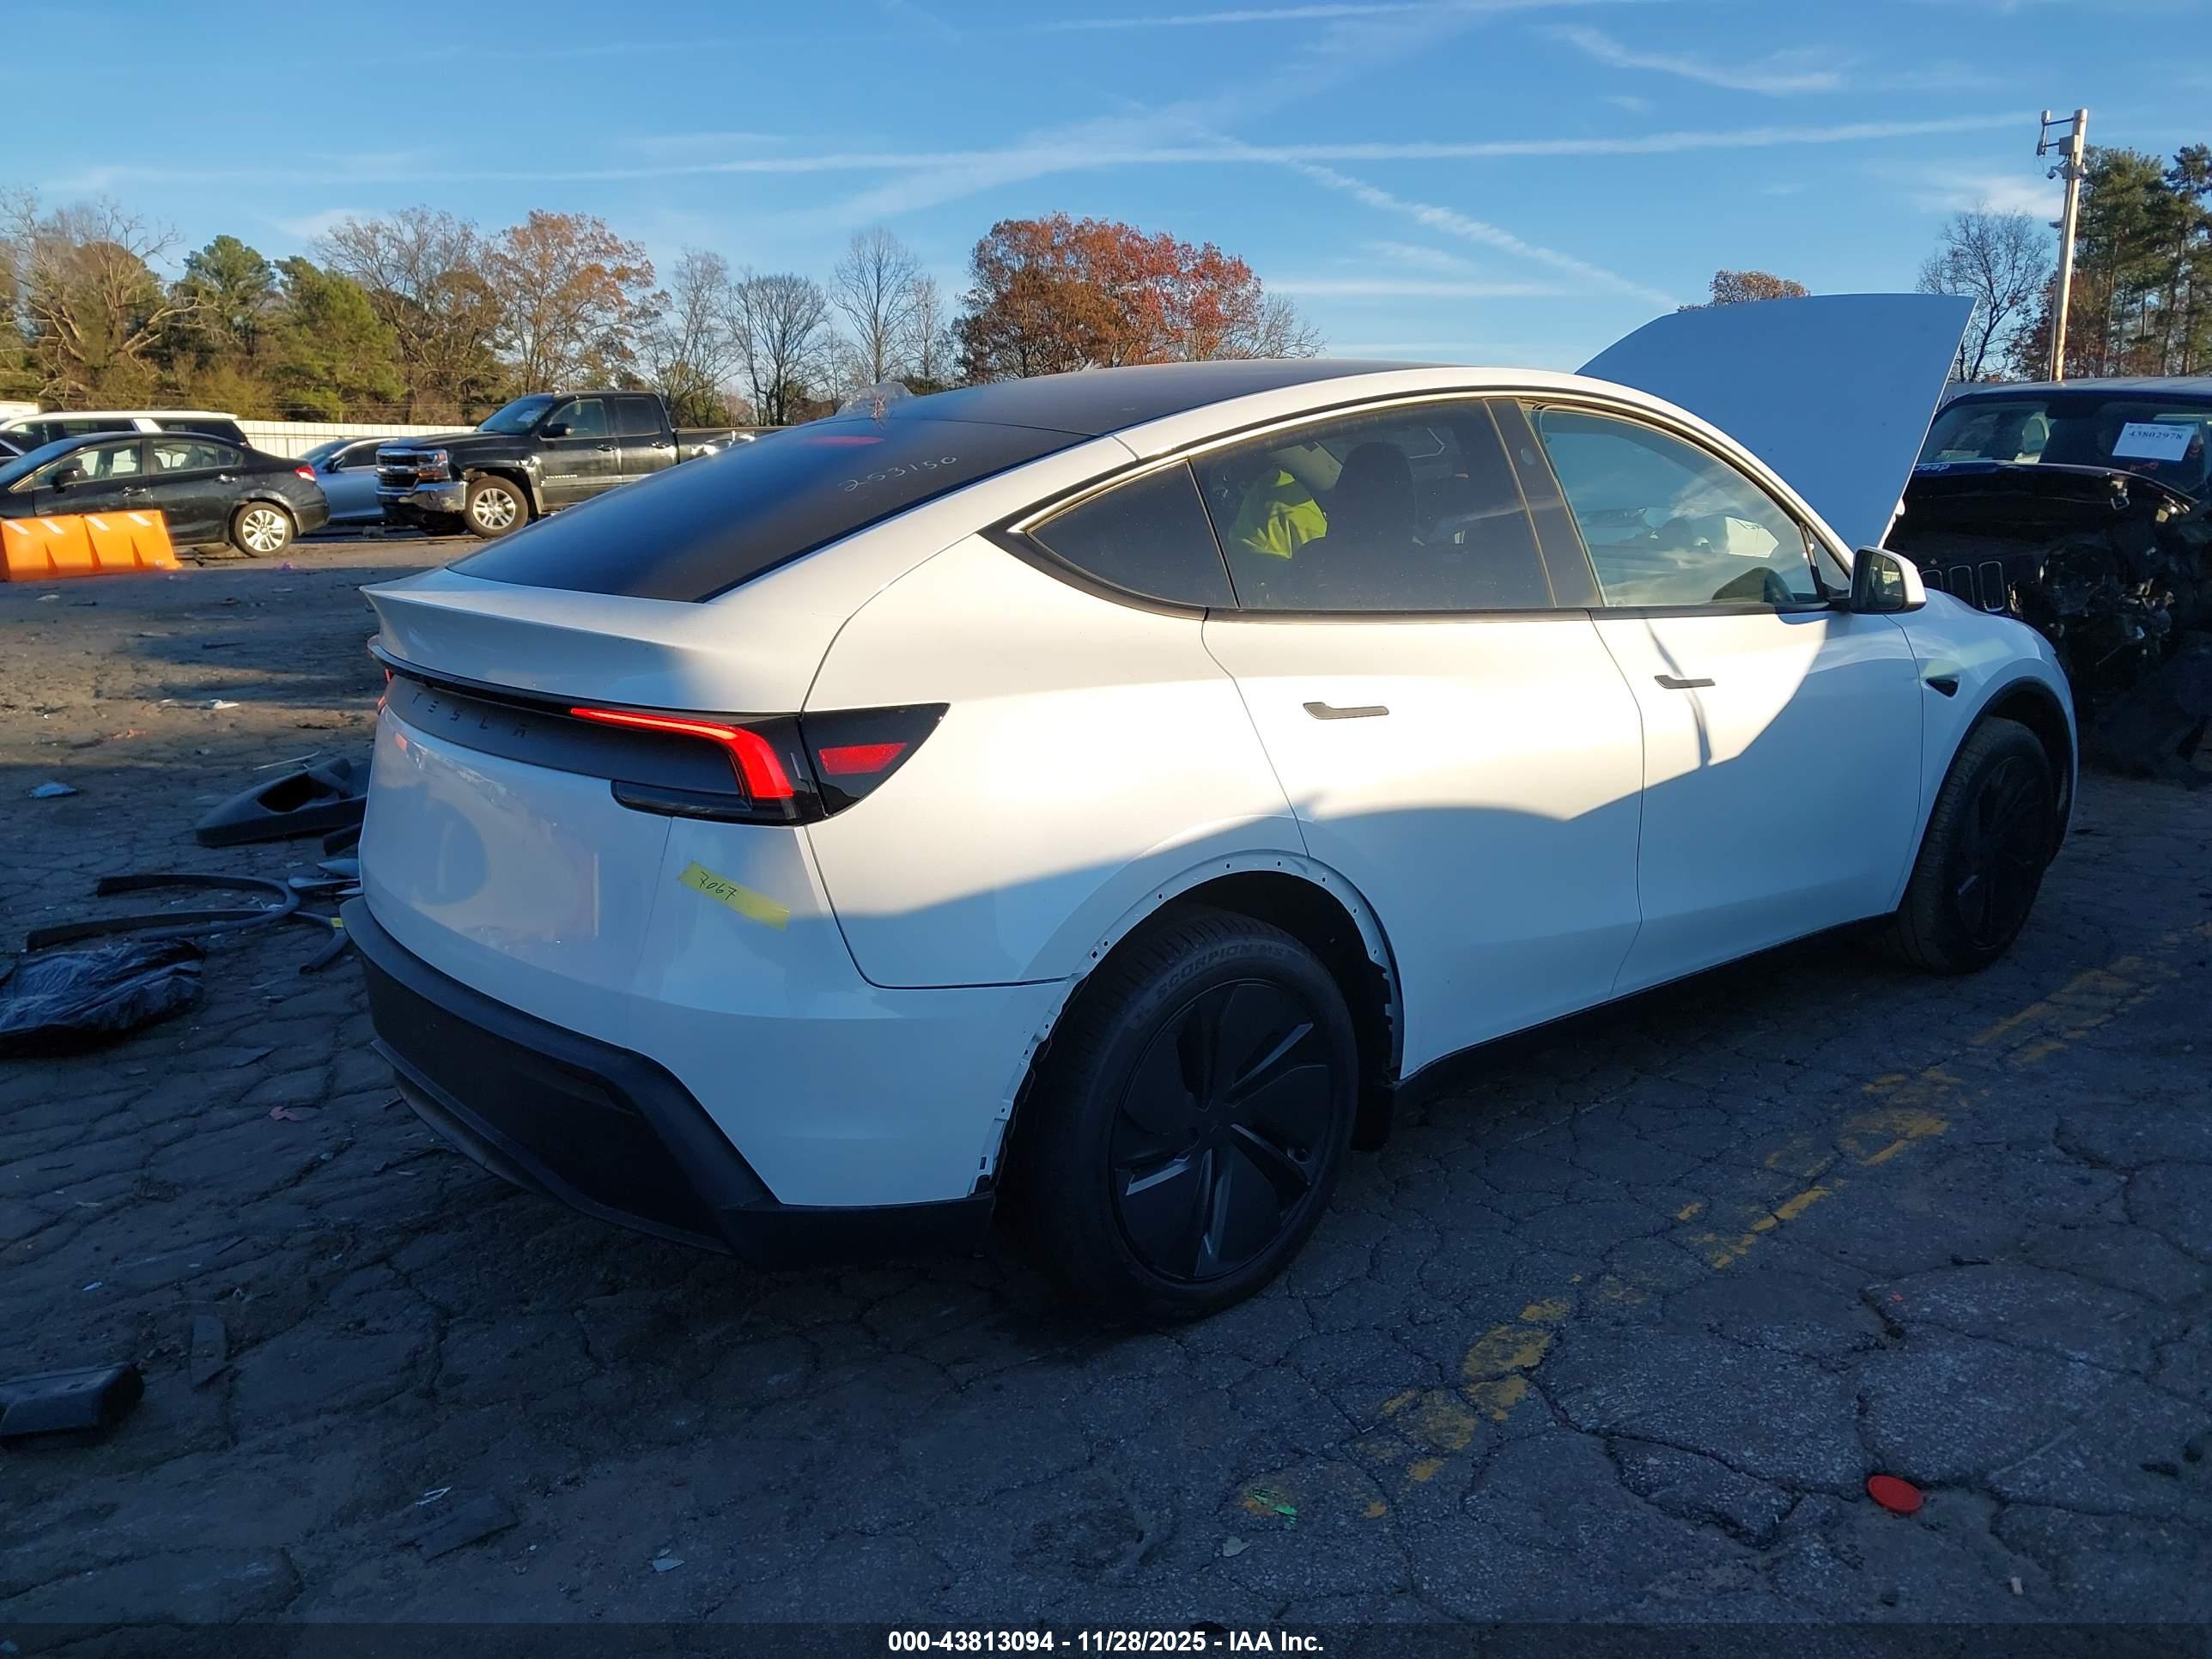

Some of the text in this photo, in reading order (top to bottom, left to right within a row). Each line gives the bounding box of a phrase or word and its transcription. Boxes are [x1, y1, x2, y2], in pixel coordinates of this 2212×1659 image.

[412, 692, 528, 738] TESLA
[699, 871, 738, 901] 7067
[1156, 943, 1253, 1000] SCORPION
